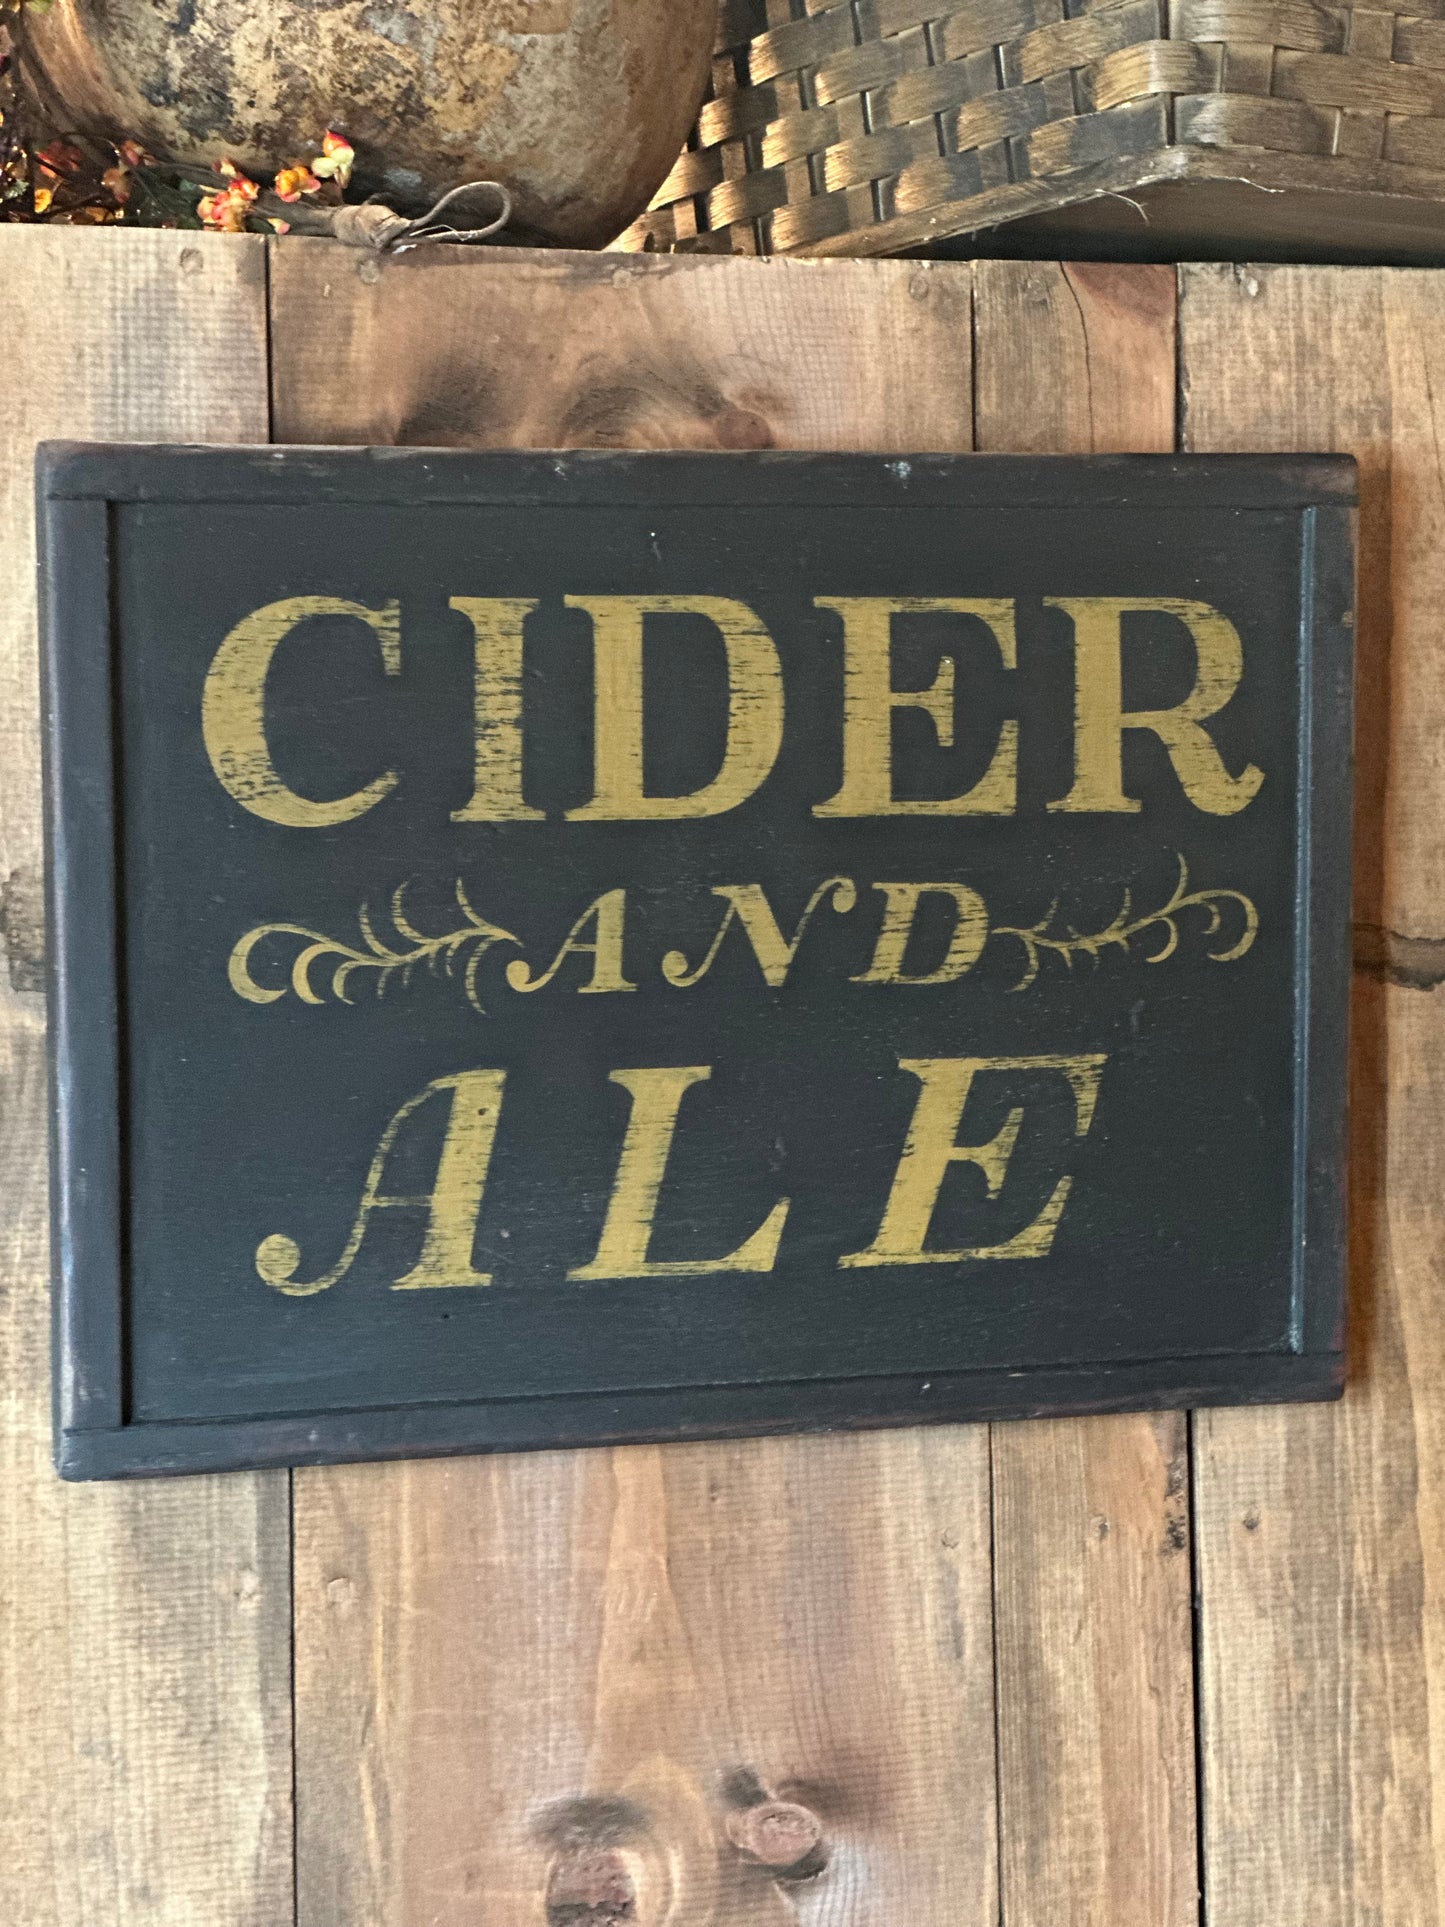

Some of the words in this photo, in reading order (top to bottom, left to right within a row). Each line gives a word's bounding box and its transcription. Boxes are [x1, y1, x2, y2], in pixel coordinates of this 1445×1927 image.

[201, 594, 1266, 828] CIDER
[506, 876, 989, 993] AND
[254, 1052, 1109, 1296] ALE
